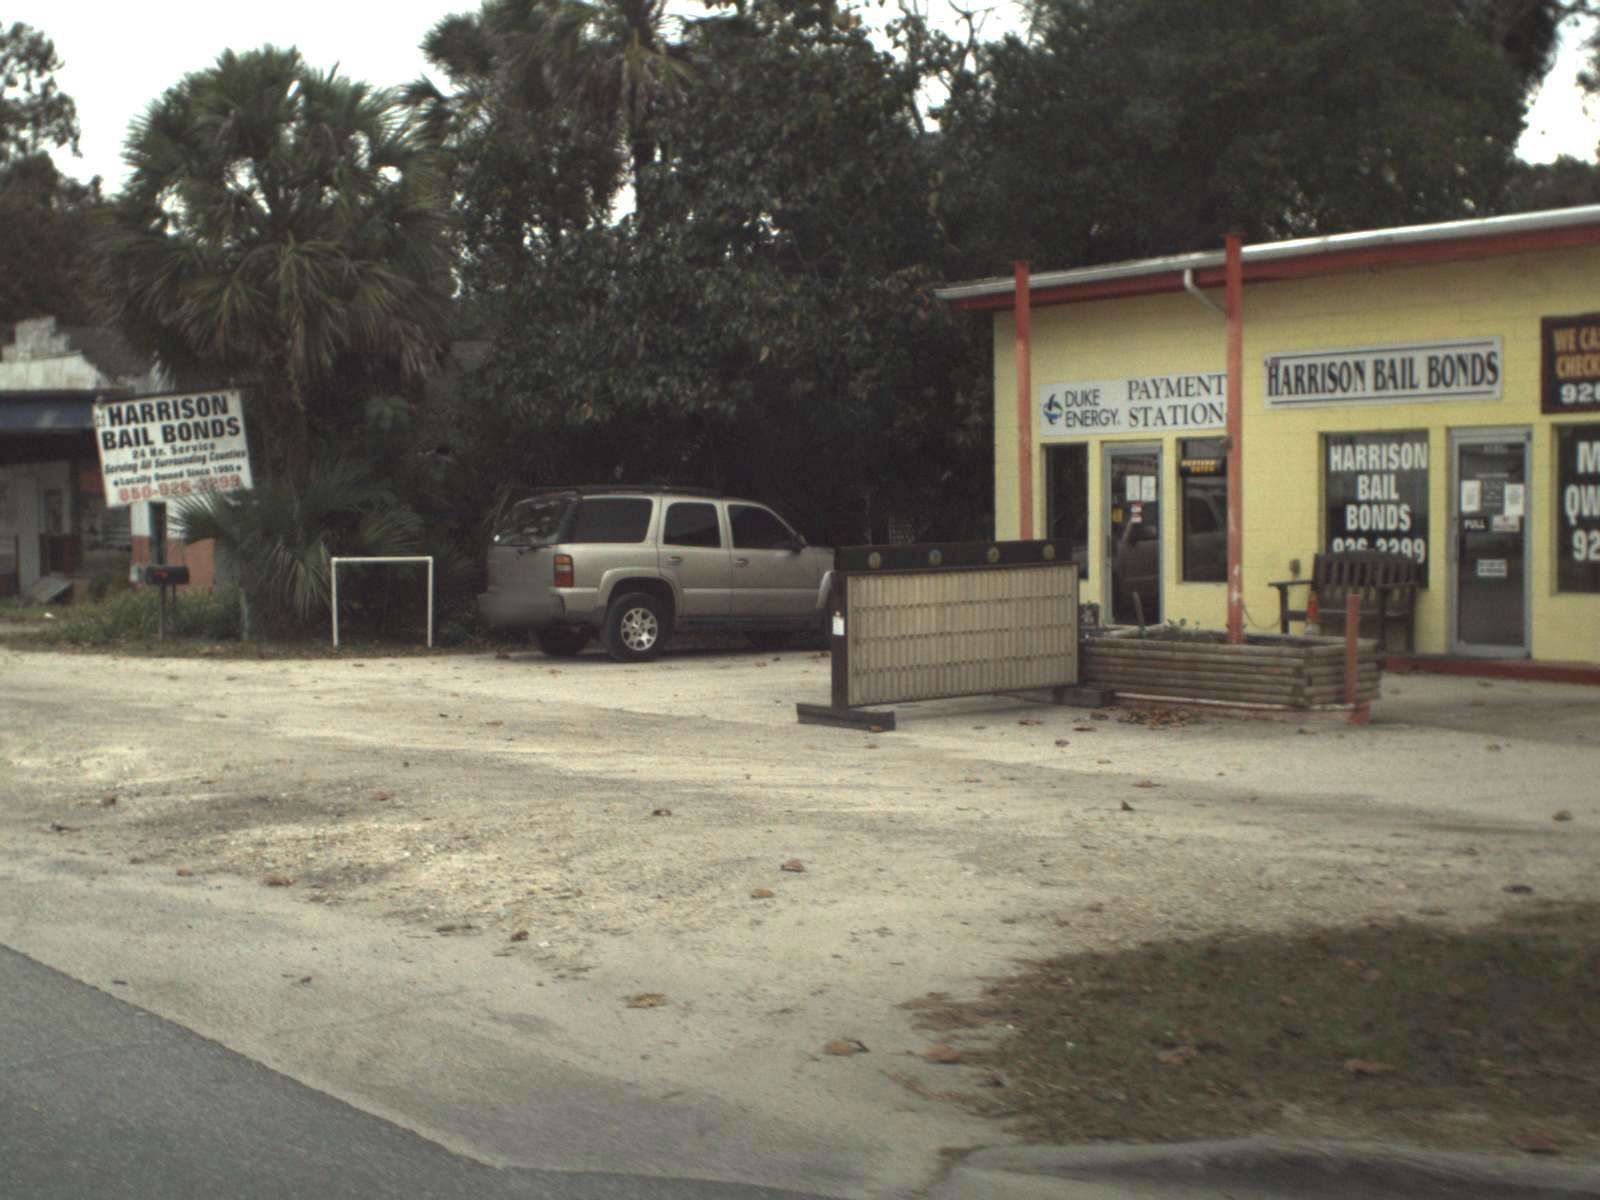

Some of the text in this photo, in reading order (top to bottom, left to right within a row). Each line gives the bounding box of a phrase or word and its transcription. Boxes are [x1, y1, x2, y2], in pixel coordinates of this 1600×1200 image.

[1553, 328, 1576, 352] WE
[1267, 351, 1499, 397] HARRISON BAIL BONDS
[1065, 389, 1100, 407] DUKE
[1128, 375, 1227, 400] PAYMENT
[108, 395, 228, 427] HARRISON
[1065, 408, 1119, 428] ENERGY
[1128, 403, 1224, 427] STATION
[102, 417, 240, 450] BAIL BONDS
[105, 462, 138, 474] Serving
[154, 454, 207, 469] Surrounding
[209, 450, 246, 462] Counties
[132, 449, 146, 459] 24
[170, 443, 215, 454] Service
[1330, 442, 1427, 471] HARRISON
[119, 475, 152, 486] Locally
[154, 471, 184, 481] Owned
[186, 466, 210, 477] Since
[1357, 475, 1399, 501] BAIL
[1346, 504, 1411, 531] BONDS
[1464, 519, 1486, 530] PULL
